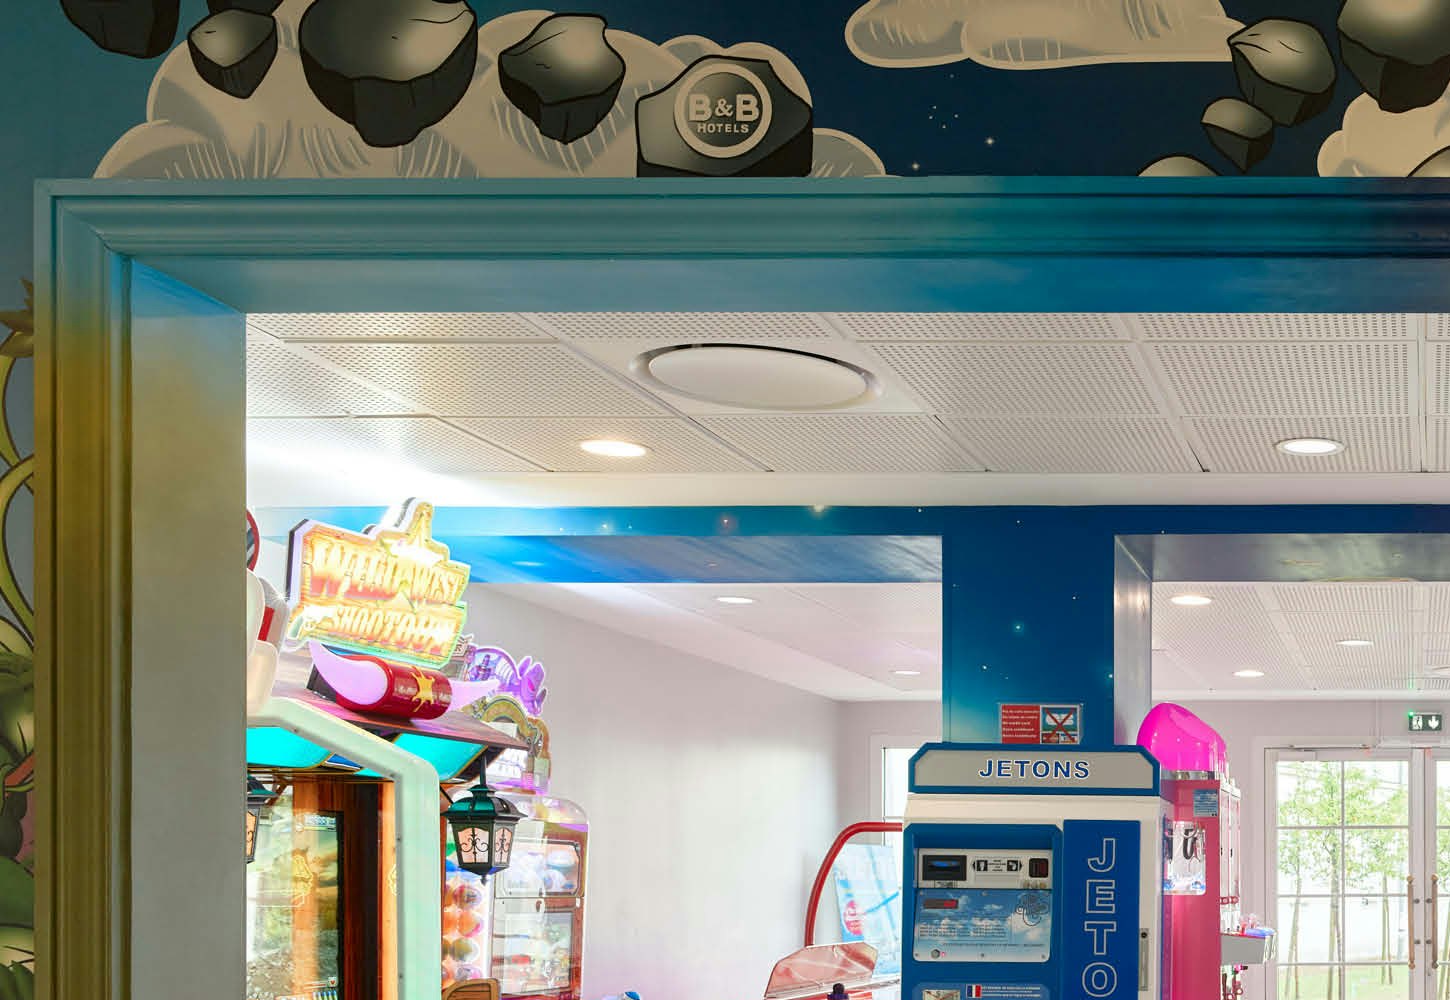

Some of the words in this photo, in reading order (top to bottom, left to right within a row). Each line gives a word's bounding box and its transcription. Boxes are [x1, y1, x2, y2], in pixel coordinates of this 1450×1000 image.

[689, 93, 760, 122] B&B
[696, 123, 750, 134] HOTELS
[979, 759, 1090, 779] JETONS
